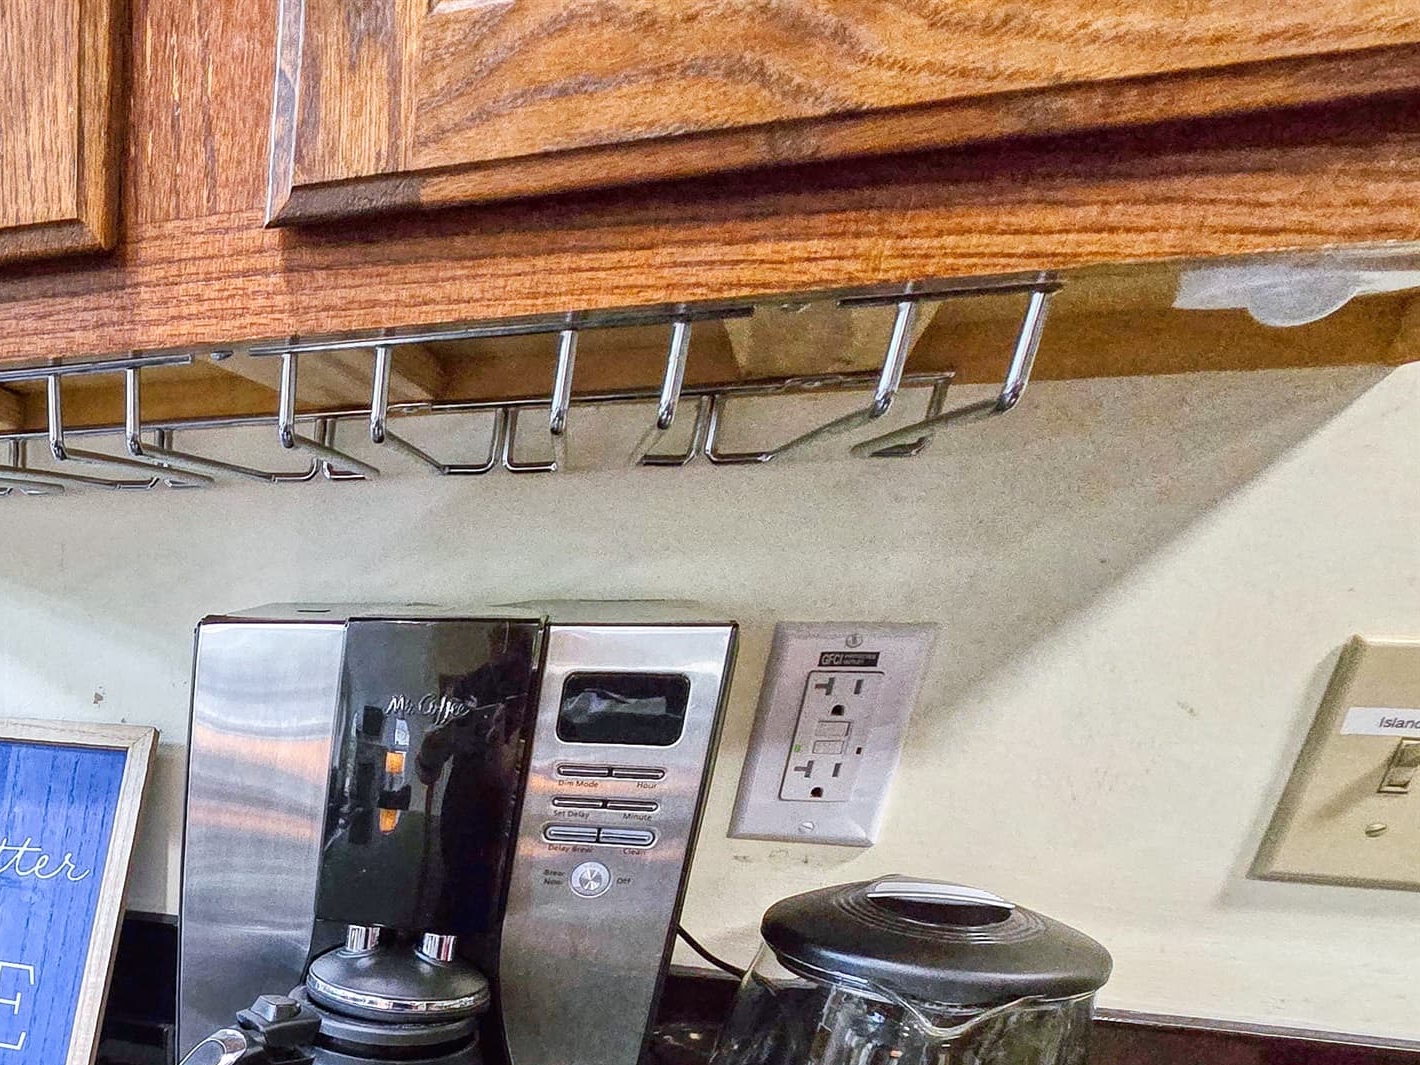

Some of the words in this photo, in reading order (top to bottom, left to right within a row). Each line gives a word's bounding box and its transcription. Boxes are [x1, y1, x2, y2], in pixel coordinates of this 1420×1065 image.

[558, 780, 574, 788] Dim
[575, 780, 599, 789] Mode
[636, 781, 657, 790] Hour
[568, 811, 590, 819] Delay
[623, 813, 652, 821] Minute
[623, 848, 646, 856] Clean
